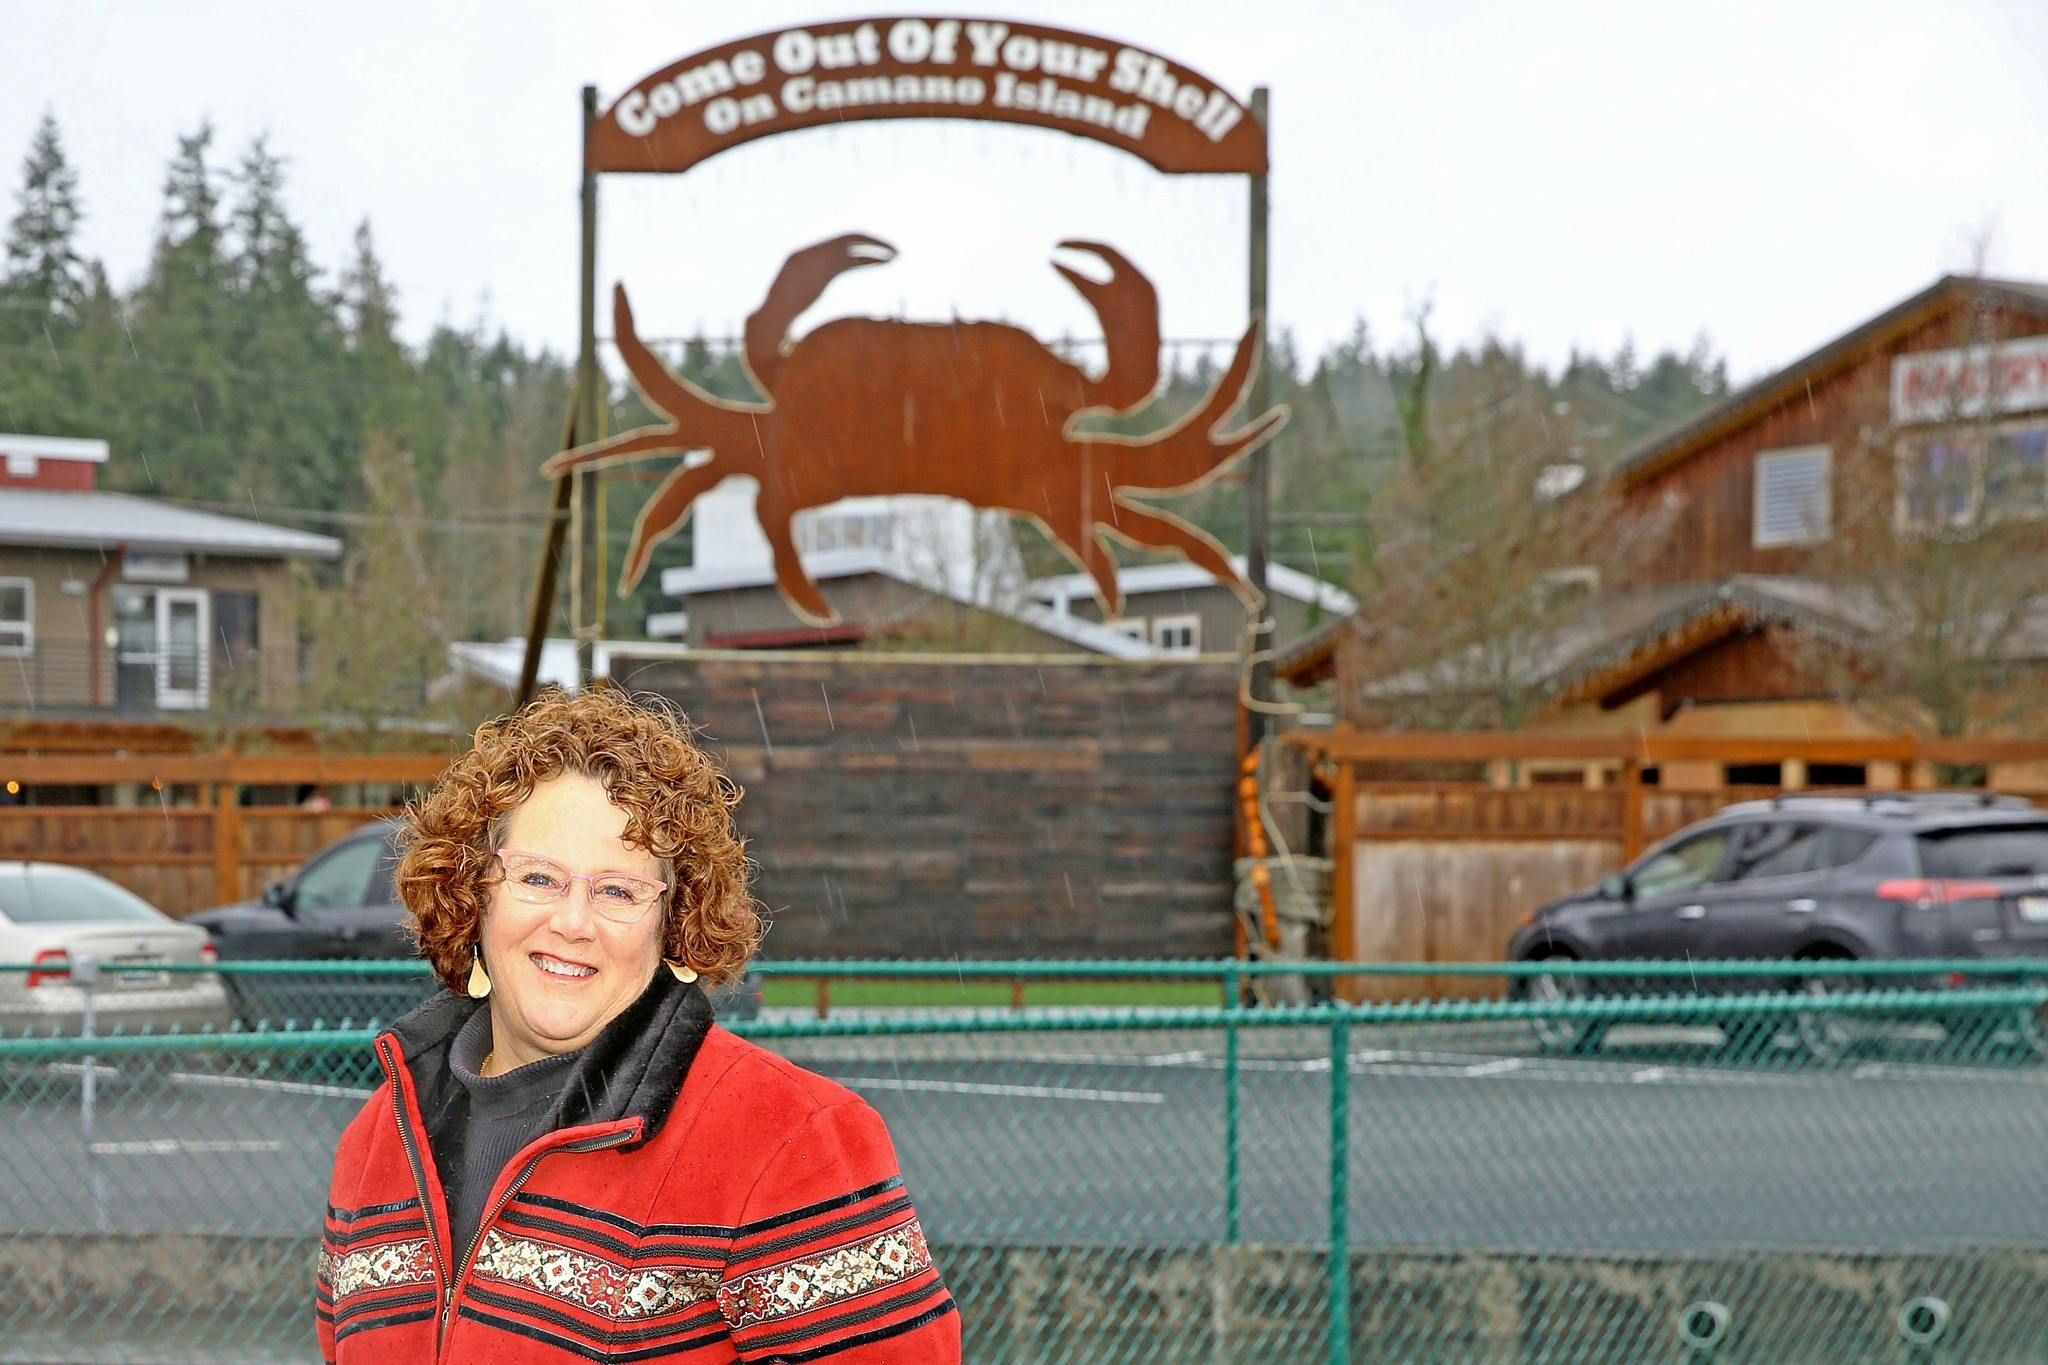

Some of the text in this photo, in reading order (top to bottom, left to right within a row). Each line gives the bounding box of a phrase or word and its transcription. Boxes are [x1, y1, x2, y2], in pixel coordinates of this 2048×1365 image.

[615, 18, 1243, 143] Come Out Of Your Shell
[704, 72, 1151, 140] On Camano Island
